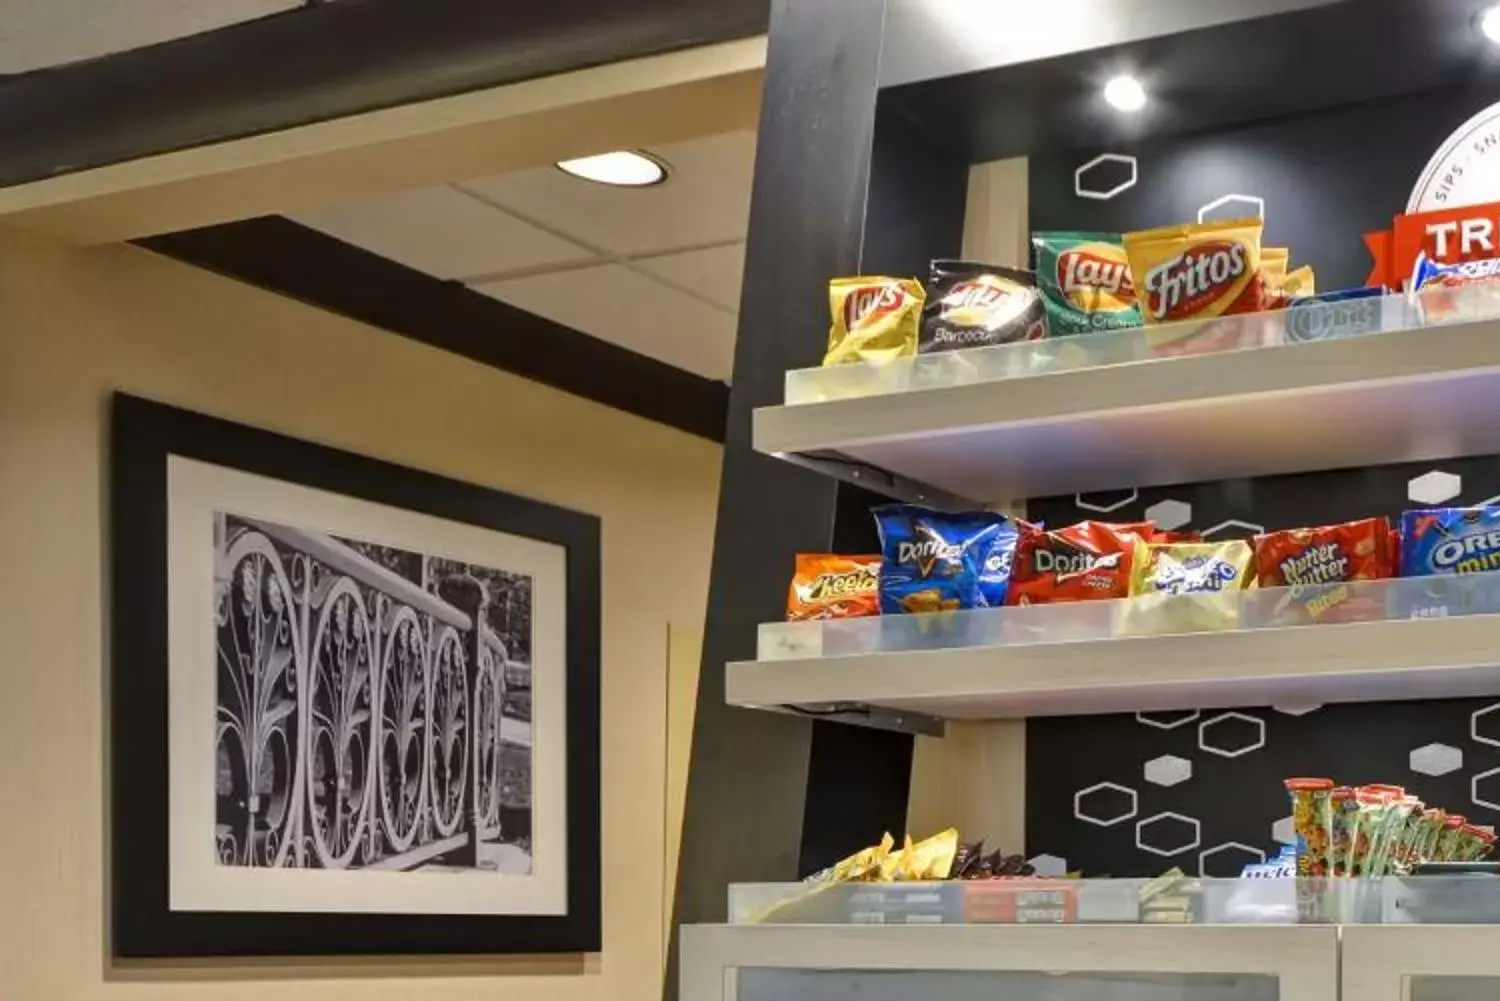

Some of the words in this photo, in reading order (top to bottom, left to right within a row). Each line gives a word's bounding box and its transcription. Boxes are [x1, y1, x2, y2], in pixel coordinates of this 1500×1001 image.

[1435, 166, 1463, 203] SIPS
[1144, 243, 1245, 317] Fritos
[1035, 549, 1121, 573] Doritos
[1280, 543, 1339, 585] Nutter
